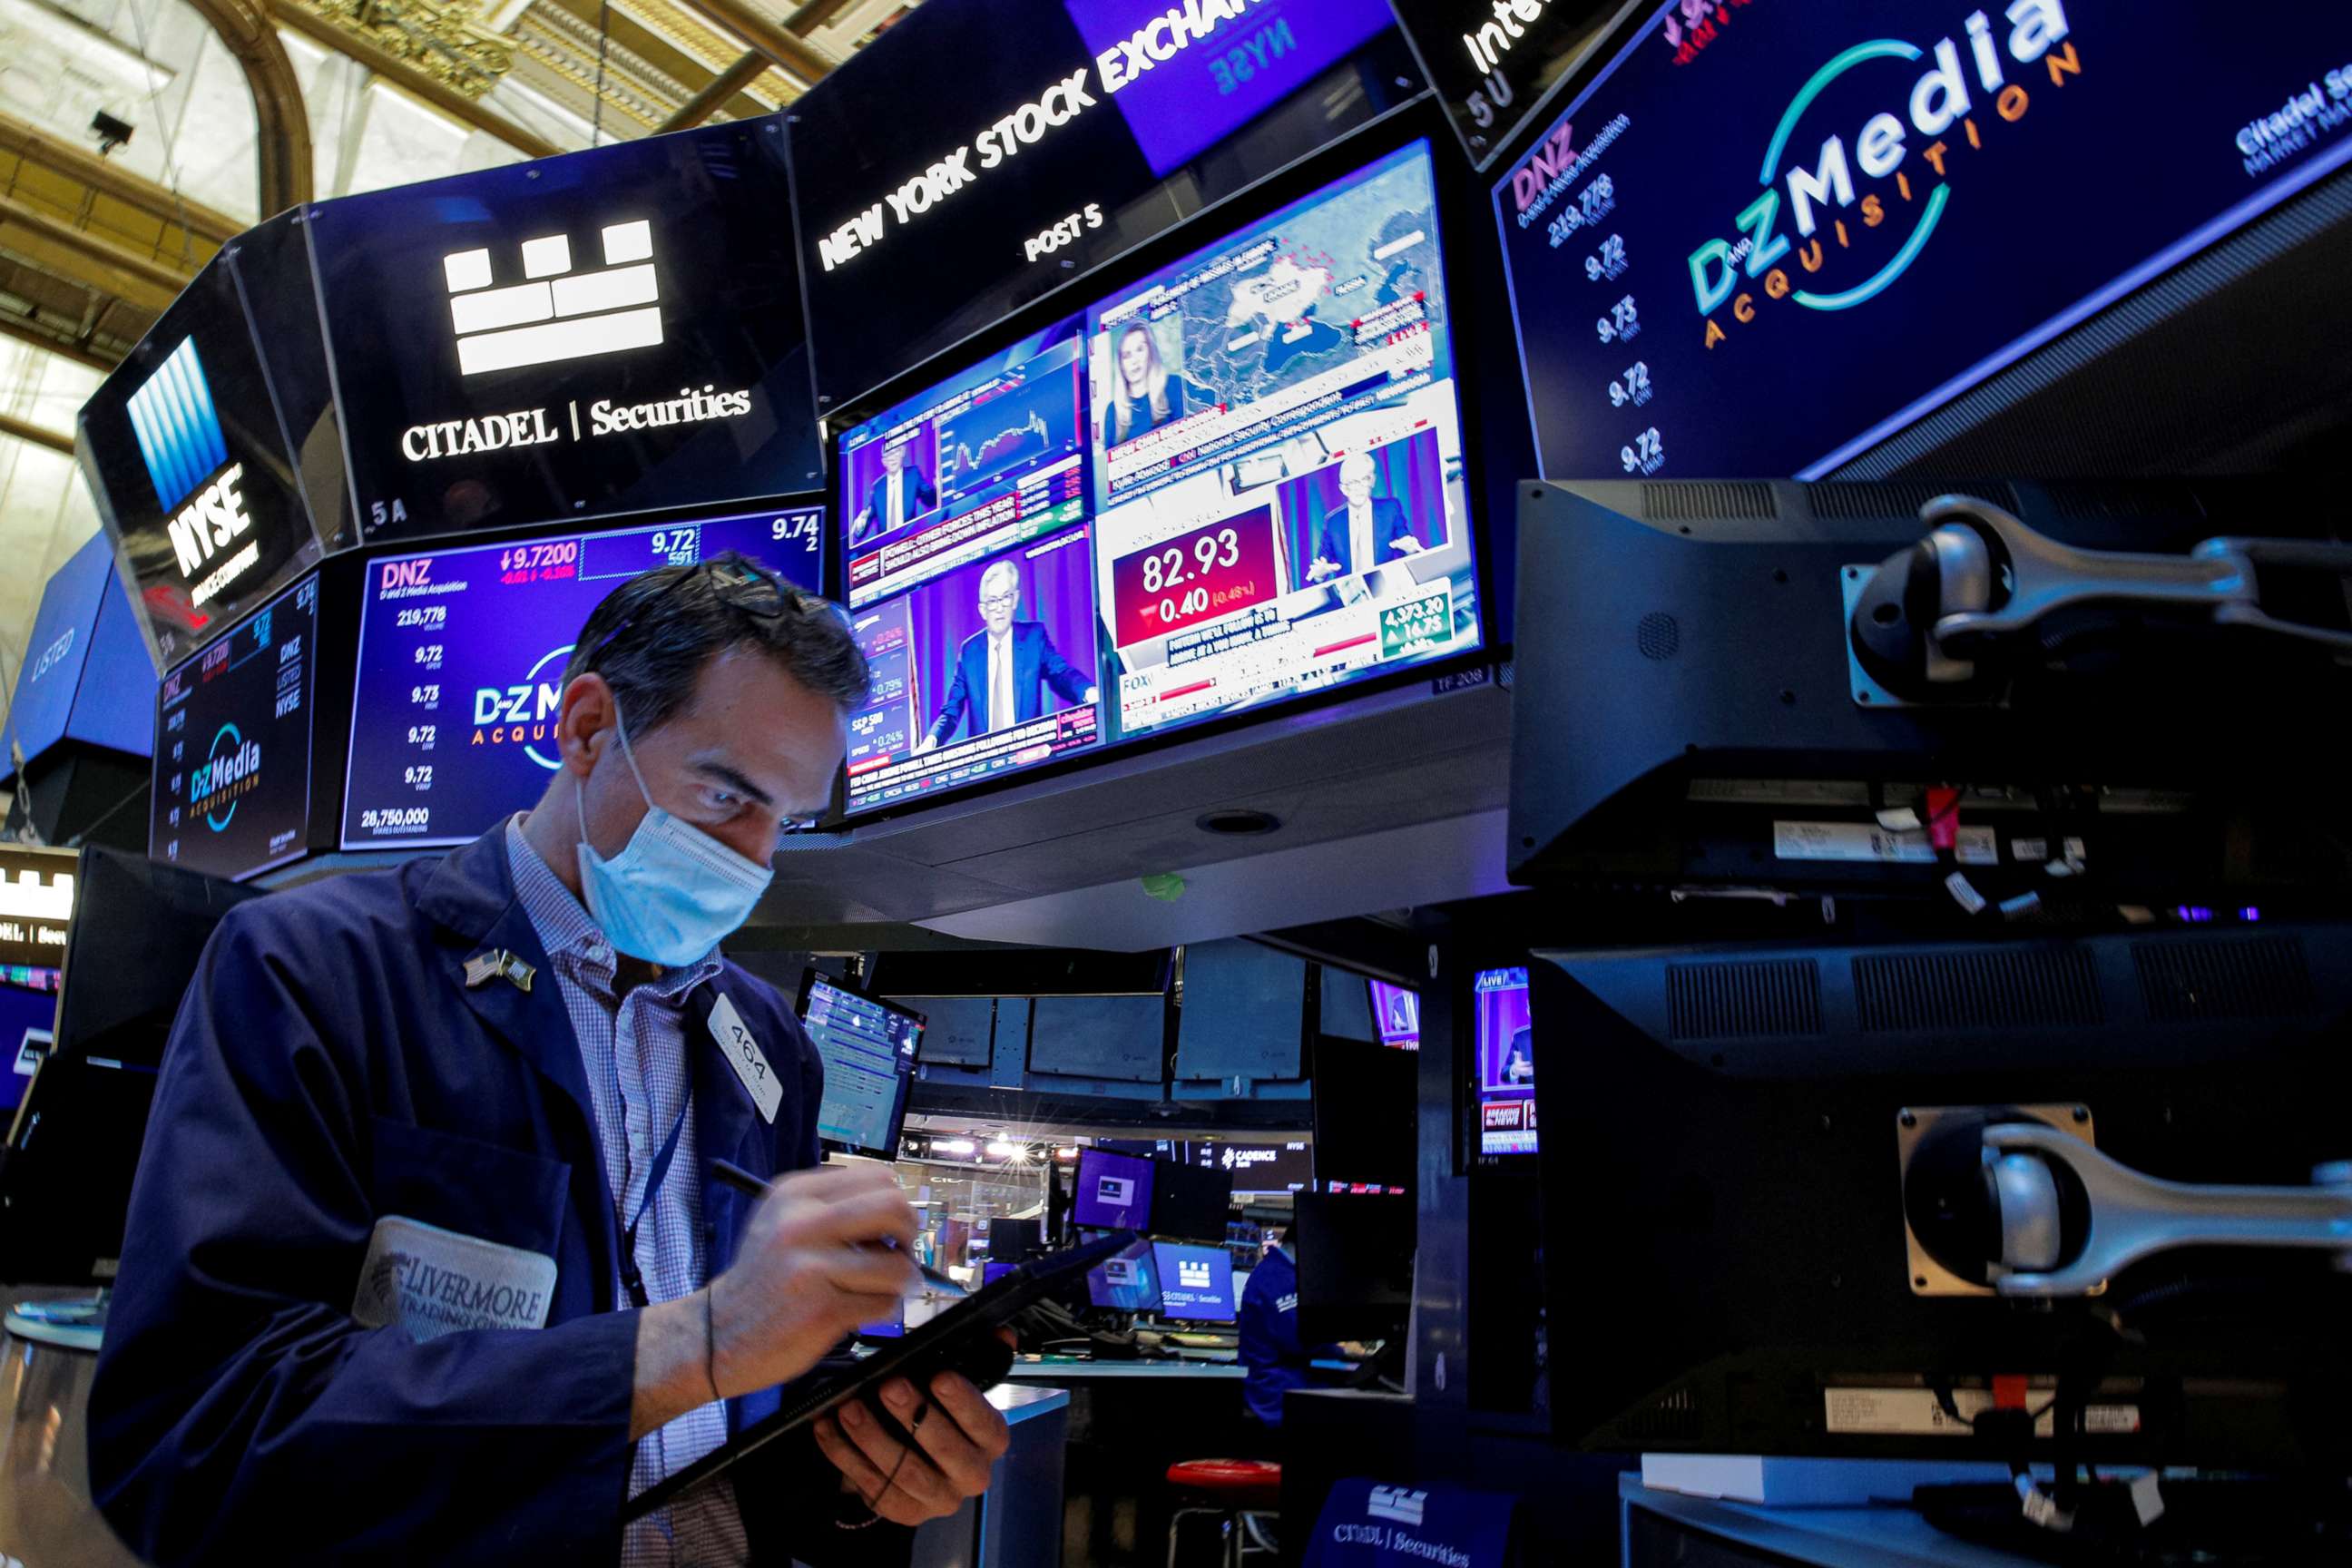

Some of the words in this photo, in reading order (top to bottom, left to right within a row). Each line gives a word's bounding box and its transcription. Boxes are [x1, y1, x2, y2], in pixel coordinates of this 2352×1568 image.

[1463, 0, 1551, 74] Inte
[818, 201, 884, 271] NEW
[886, 146, 976, 225] YORK
[976, 68, 1098, 169] STOCK
[1095, 0, 1266, 94] EXCHA
[1786, 0, 2070, 237] Media
[2236, 82, 2326, 155] Citadel
[1513, 122, 1579, 211] DNZ
[1547, 172, 1614, 248] 219,778
[1704, 42, 2082, 348] ACQUISITION
[1024, 218, 1083, 263] POST
[1083, 201, 1103, 230] 5
[1584, 233, 1626, 282] 9.72
[1597, 294, 1638, 344] 9.73
[1608, 360, 1651, 407] 9.72
[402, 408, 558, 461] CITADEL
[591, 384, 752, 437] Securities
[1197, 434, 1233, 457] National
[1232, 420, 1270, 443] Security
[1270, 391, 1343, 426] Correspondent
[1621, 426, 1663, 473] 9.72
[167, 462, 251, 578] NYSE
[652, 528, 697, 554] 9.72
[772, 514, 819, 541] 9.74
[381, 559, 433, 590] DNZ
[514, 542, 578, 571] 9.7200
[806, 536, 818, 553] 2
[1142, 527, 1240, 593] 82.93
[427, 581, 468, 596] Acquisition
[1160, 587, 1209, 622] 0.40
[1384, 595, 1445, 627] 4,373.20
[397, 606, 447, 627] 219,778
[31, 627, 75, 683] LISTED
[279, 634, 302, 664] DNZ
[415, 645, 444, 664] 9.72
[275, 688, 301, 720] NYSE
[411, 685, 440, 703] 9.73
[1123, 675, 1148, 692] FOX
[407, 725, 436, 744] 9.72
[211, 740, 261, 792] Media
[405, 765, 433, 784] 9.72
[190, 773, 260, 818] ACQUISITION
[361, 807, 430, 828] 28,750,000
[1483, 975, 1504, 987] LIVE
[730, 1024, 766, 1081] 464
[1493, 1116, 1520, 1127] NEWS
[1235, 1150, 1278, 1163] CADENCE
[406, 1257, 542, 1322] LIVERMORE
